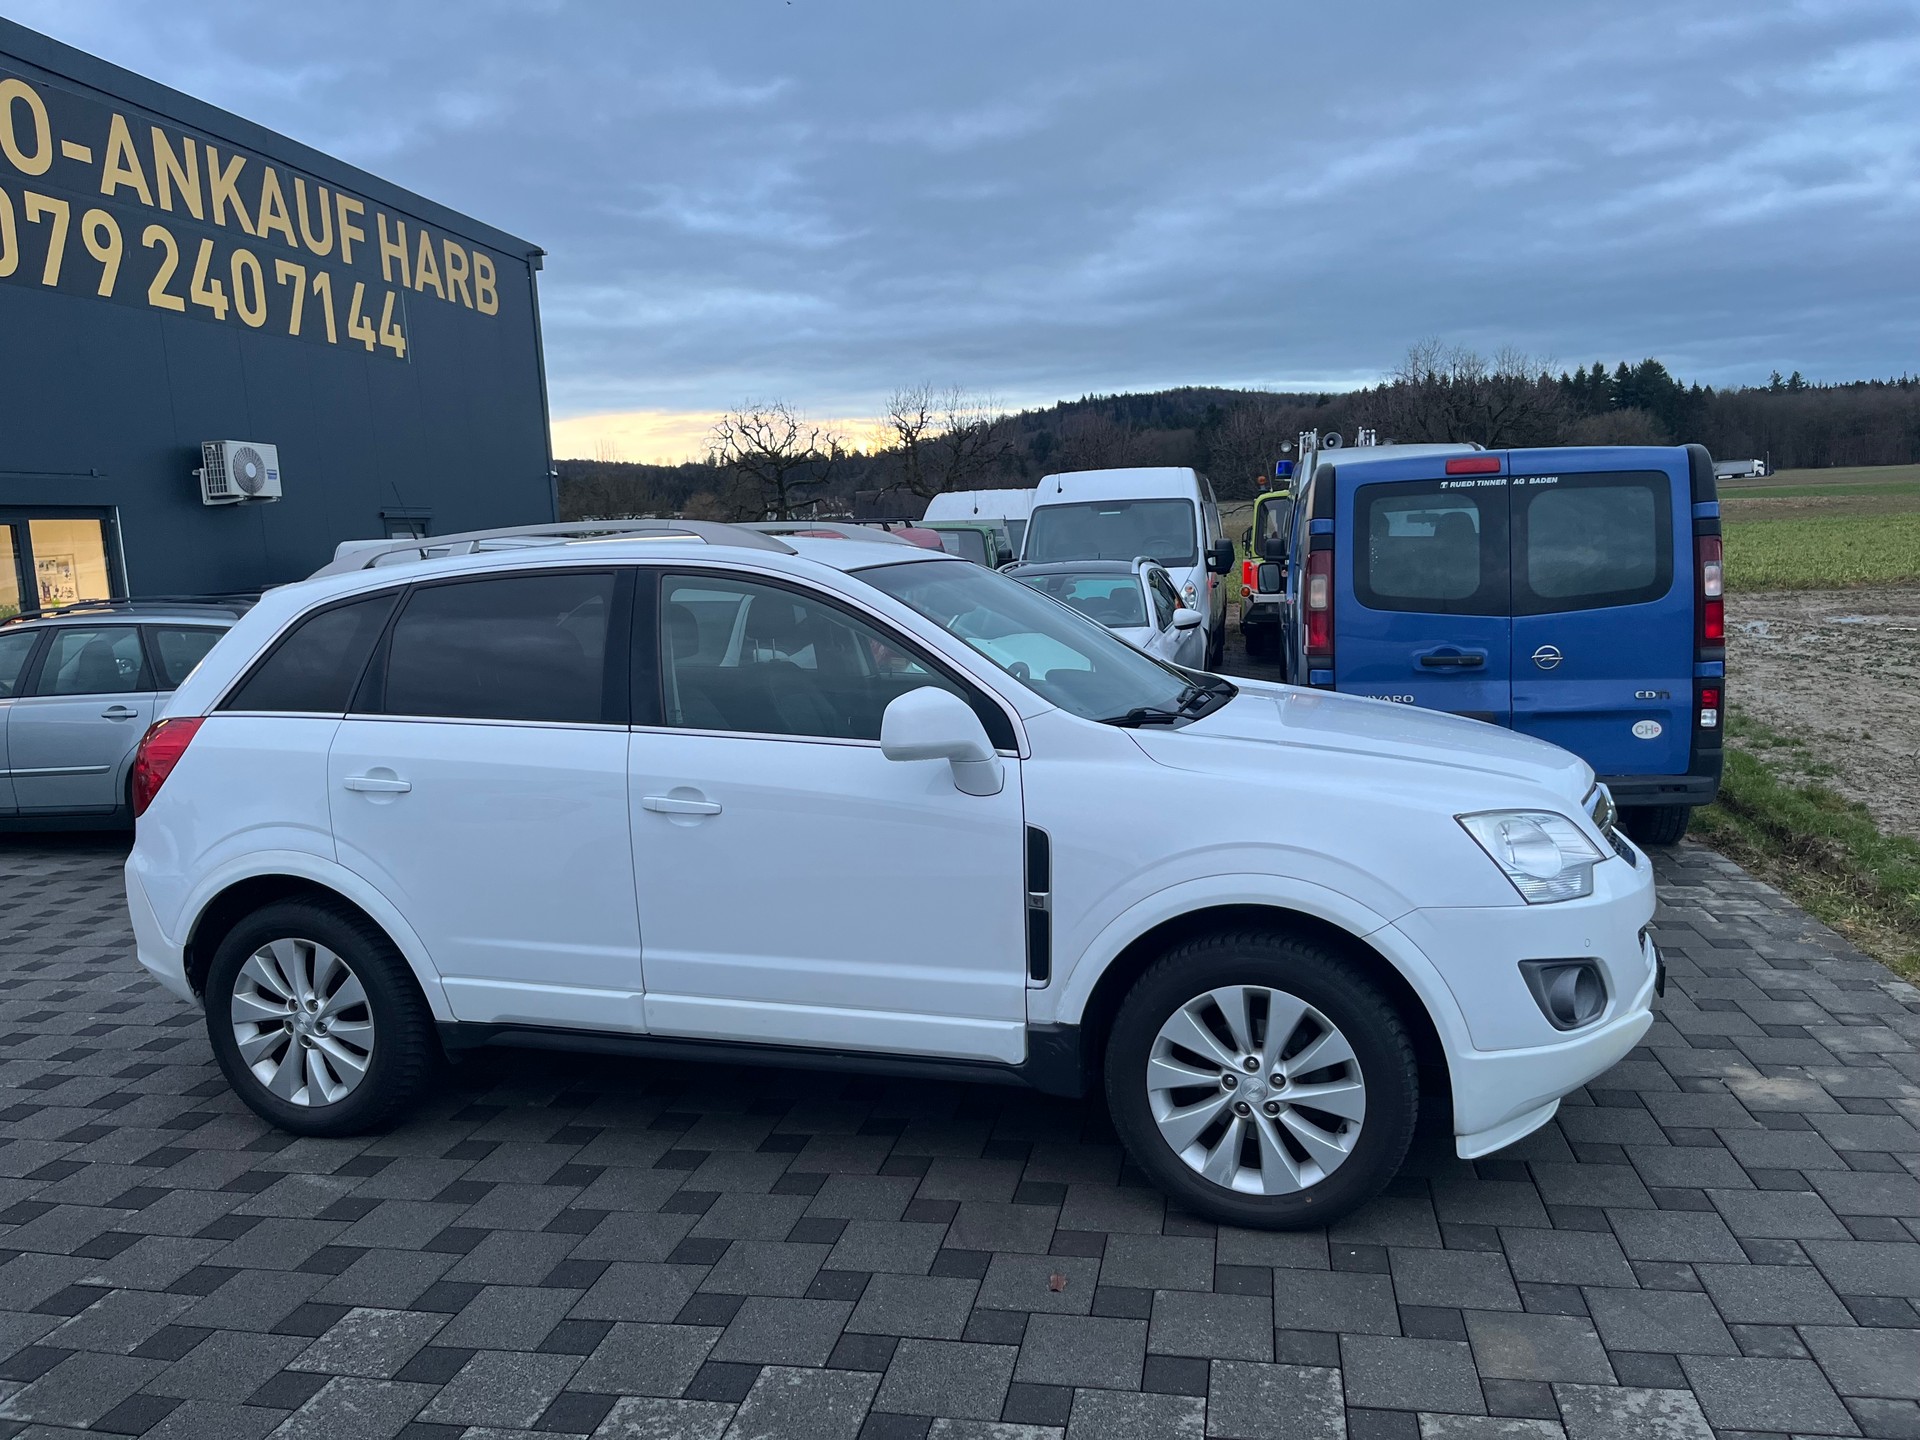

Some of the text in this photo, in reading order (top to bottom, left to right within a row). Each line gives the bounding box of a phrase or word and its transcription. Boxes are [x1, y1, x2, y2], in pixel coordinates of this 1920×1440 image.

[378, 213, 499, 316] HARB
[1477, 479, 1507, 487] TINNER
[1635, 725, 1653, 735] CH
